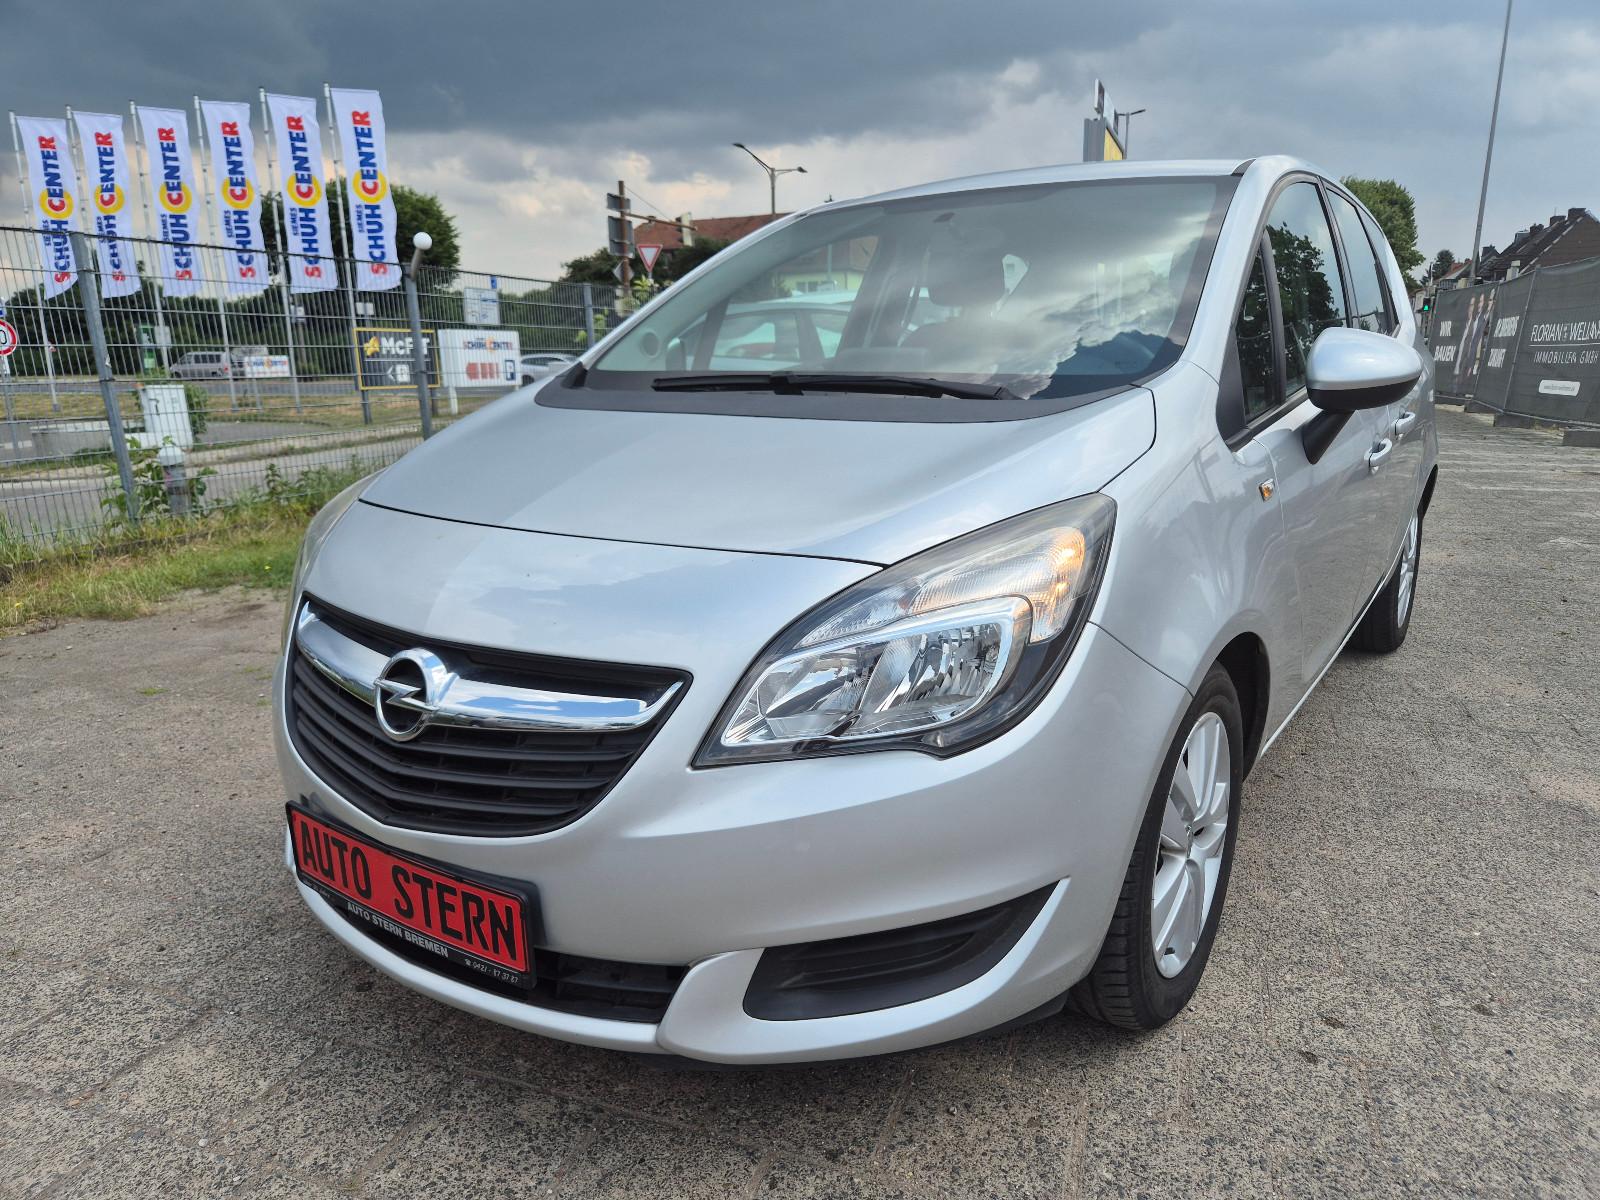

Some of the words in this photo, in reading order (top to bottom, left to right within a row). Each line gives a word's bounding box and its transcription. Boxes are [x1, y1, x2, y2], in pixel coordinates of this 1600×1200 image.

[38, 135, 66, 212] CENTER
[94, 131, 116, 206] CENTER
[157, 128, 183, 206] CENTER
[221, 121, 247, 201] CENTER
[286, 116, 314, 199] CENTER
[352, 111, 379, 195] CENTER
[49, 219, 72, 284] SCHUH
[102, 215, 126, 282] SCHUH
[169, 214, 193, 281] SCHUH
[233, 210, 256, 278] SCHUH
[298, 208, 321, 278] SCHUH
[364, 204, 388, 275] SCHUH
[381, 336, 430, 355] McFT
[1530, 323, 1563, 341] FLORIAN
[300, 820, 373, 900] AUTO
[391, 864, 517, 961] STERN
[347, 902, 370, 921] AUTO
[372, 914, 403, 939] STERN
[404, 931, 449, 958] BREMEN
